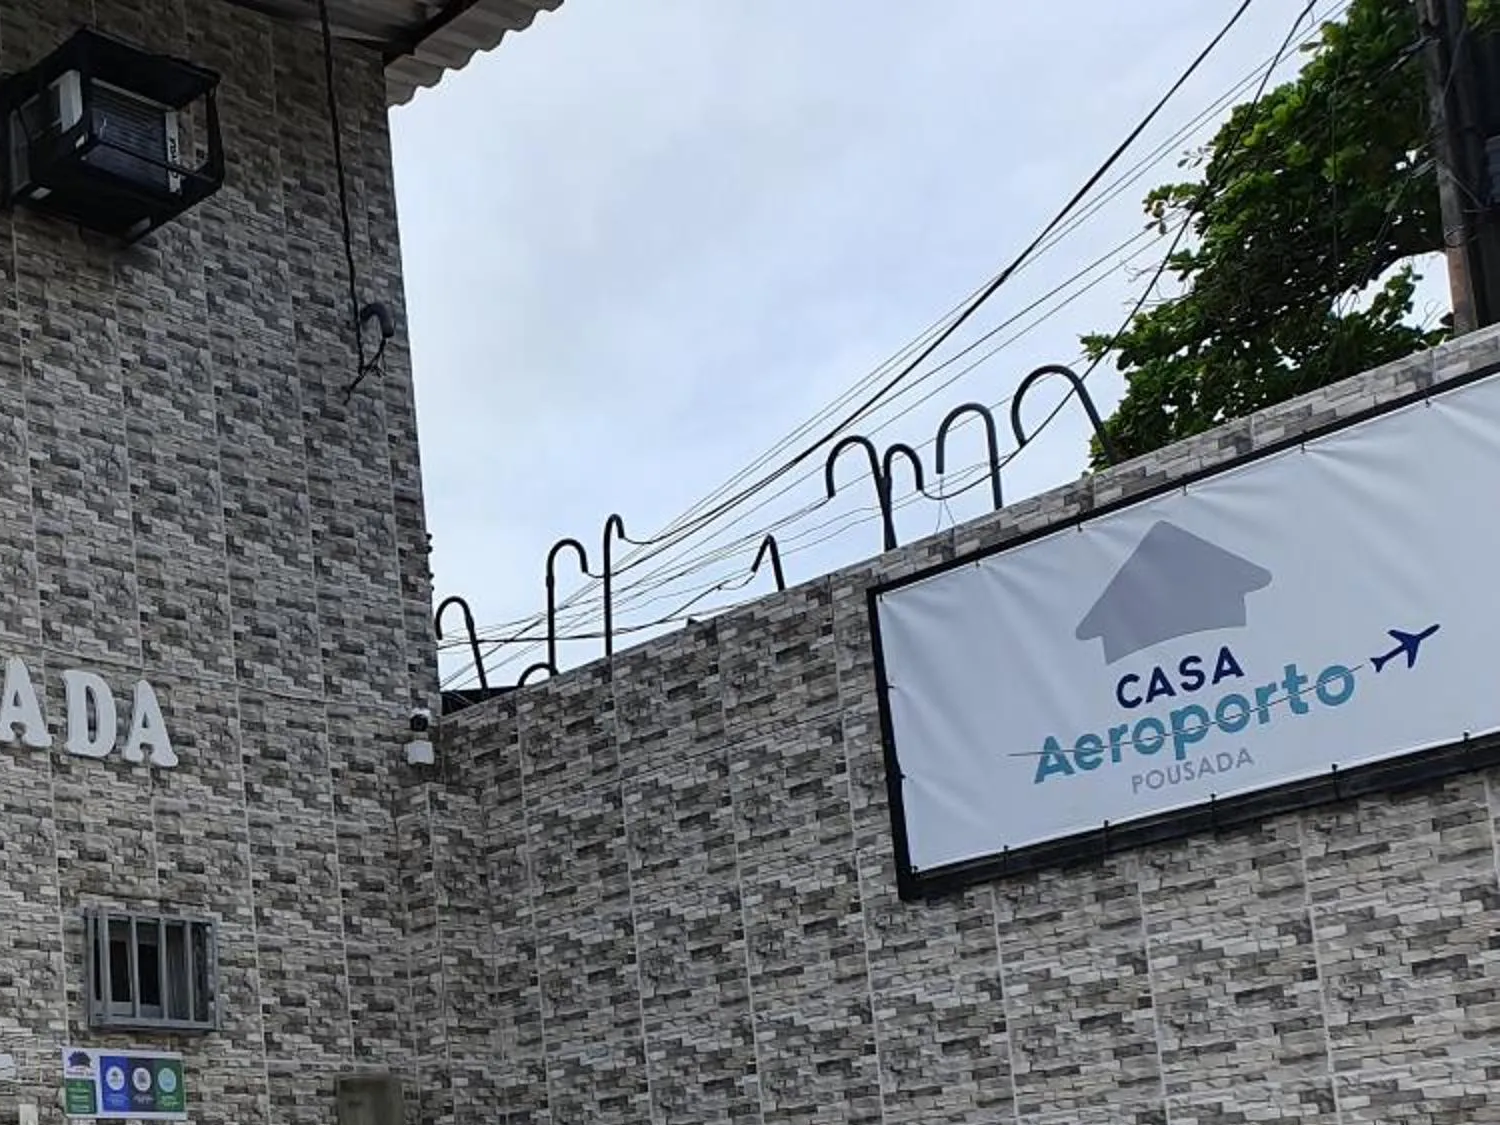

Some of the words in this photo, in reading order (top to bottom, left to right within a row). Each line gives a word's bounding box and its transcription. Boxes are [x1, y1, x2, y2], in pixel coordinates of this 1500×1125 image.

[1115, 645, 1245, 709] CASA
[1033, 662, 1356, 785] Aeroporto
[1131, 747, 1255, 794] POUSADA
